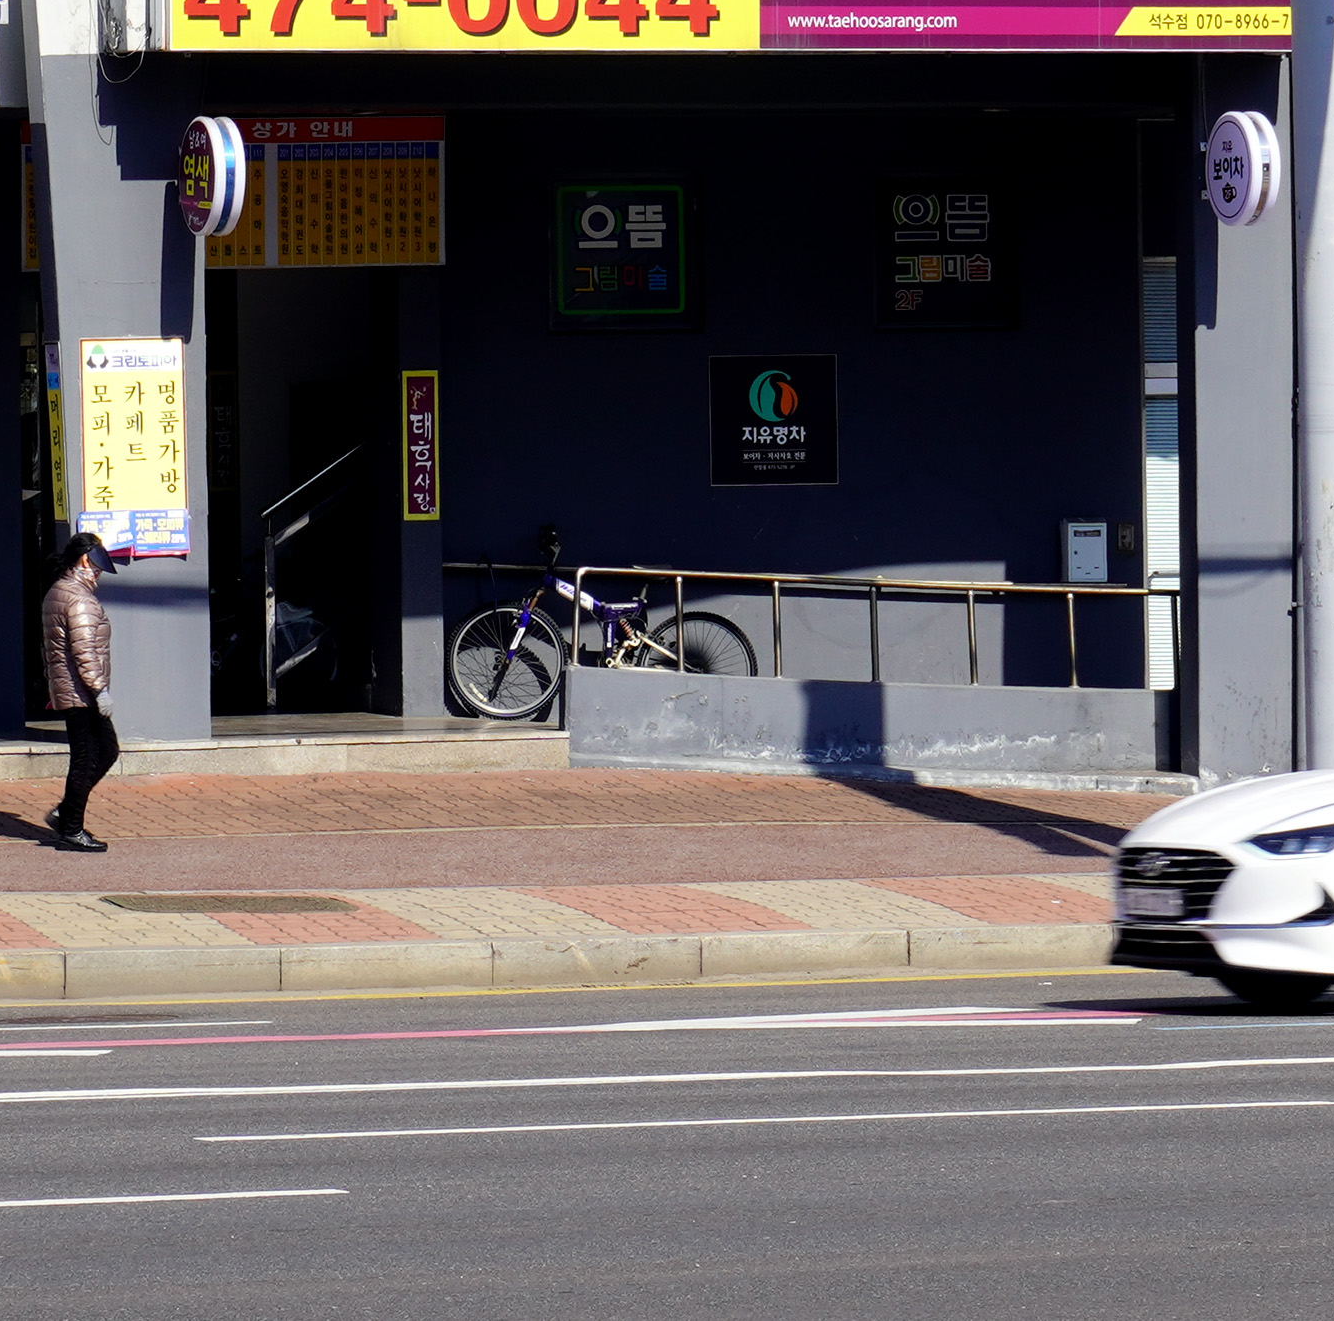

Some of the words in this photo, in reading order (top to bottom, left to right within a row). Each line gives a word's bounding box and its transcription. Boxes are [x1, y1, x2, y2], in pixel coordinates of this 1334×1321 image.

[788, 13, 957, 32] www.taehoosarang.com
[1149, 11, 1188, 31] 석수점
[252, 121, 297, 138] 상가
[309, 120, 353, 138] 안내
[183, 153, 210, 198] 염색
[1213, 156, 1244, 180] 보이차
[574, 203, 667, 249] 으뜸
[893, 194, 990, 242] 으뜸
[895, 253, 992, 283] 그림미술
[895, 289, 924, 310] 2F
[124, 381, 147, 462] 카페트
[158, 380, 181, 493] 명품가방
[741, 425, 806, 445] 지유명차
[90, 383, 114, 510] 모피·가죽
